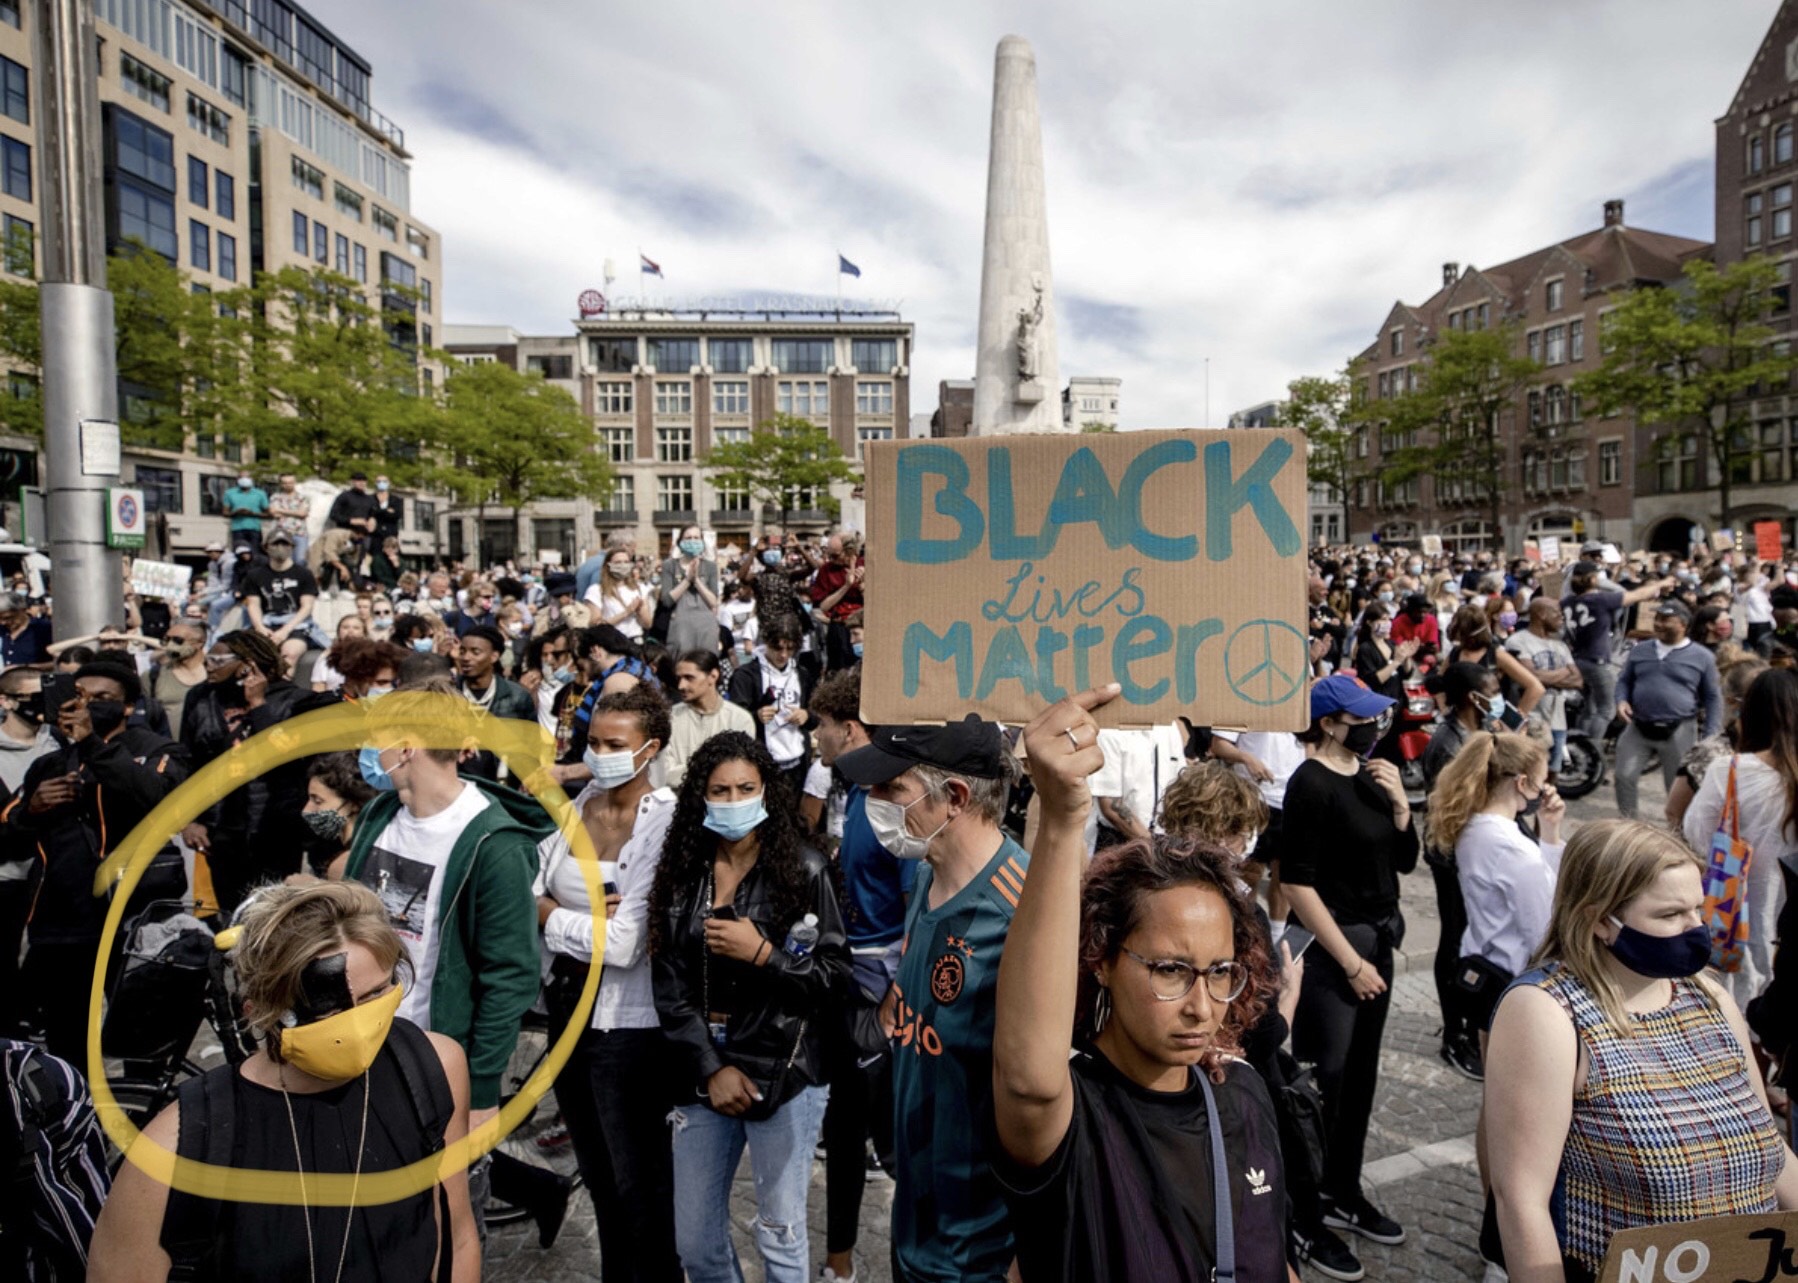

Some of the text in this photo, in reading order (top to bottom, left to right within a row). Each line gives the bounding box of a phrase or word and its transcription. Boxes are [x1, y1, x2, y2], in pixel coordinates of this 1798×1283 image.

[896, 437, 1302, 564] BLACK
[981, 562, 1146, 623] Lives
[1619, 1240, 1711, 1283] NO
